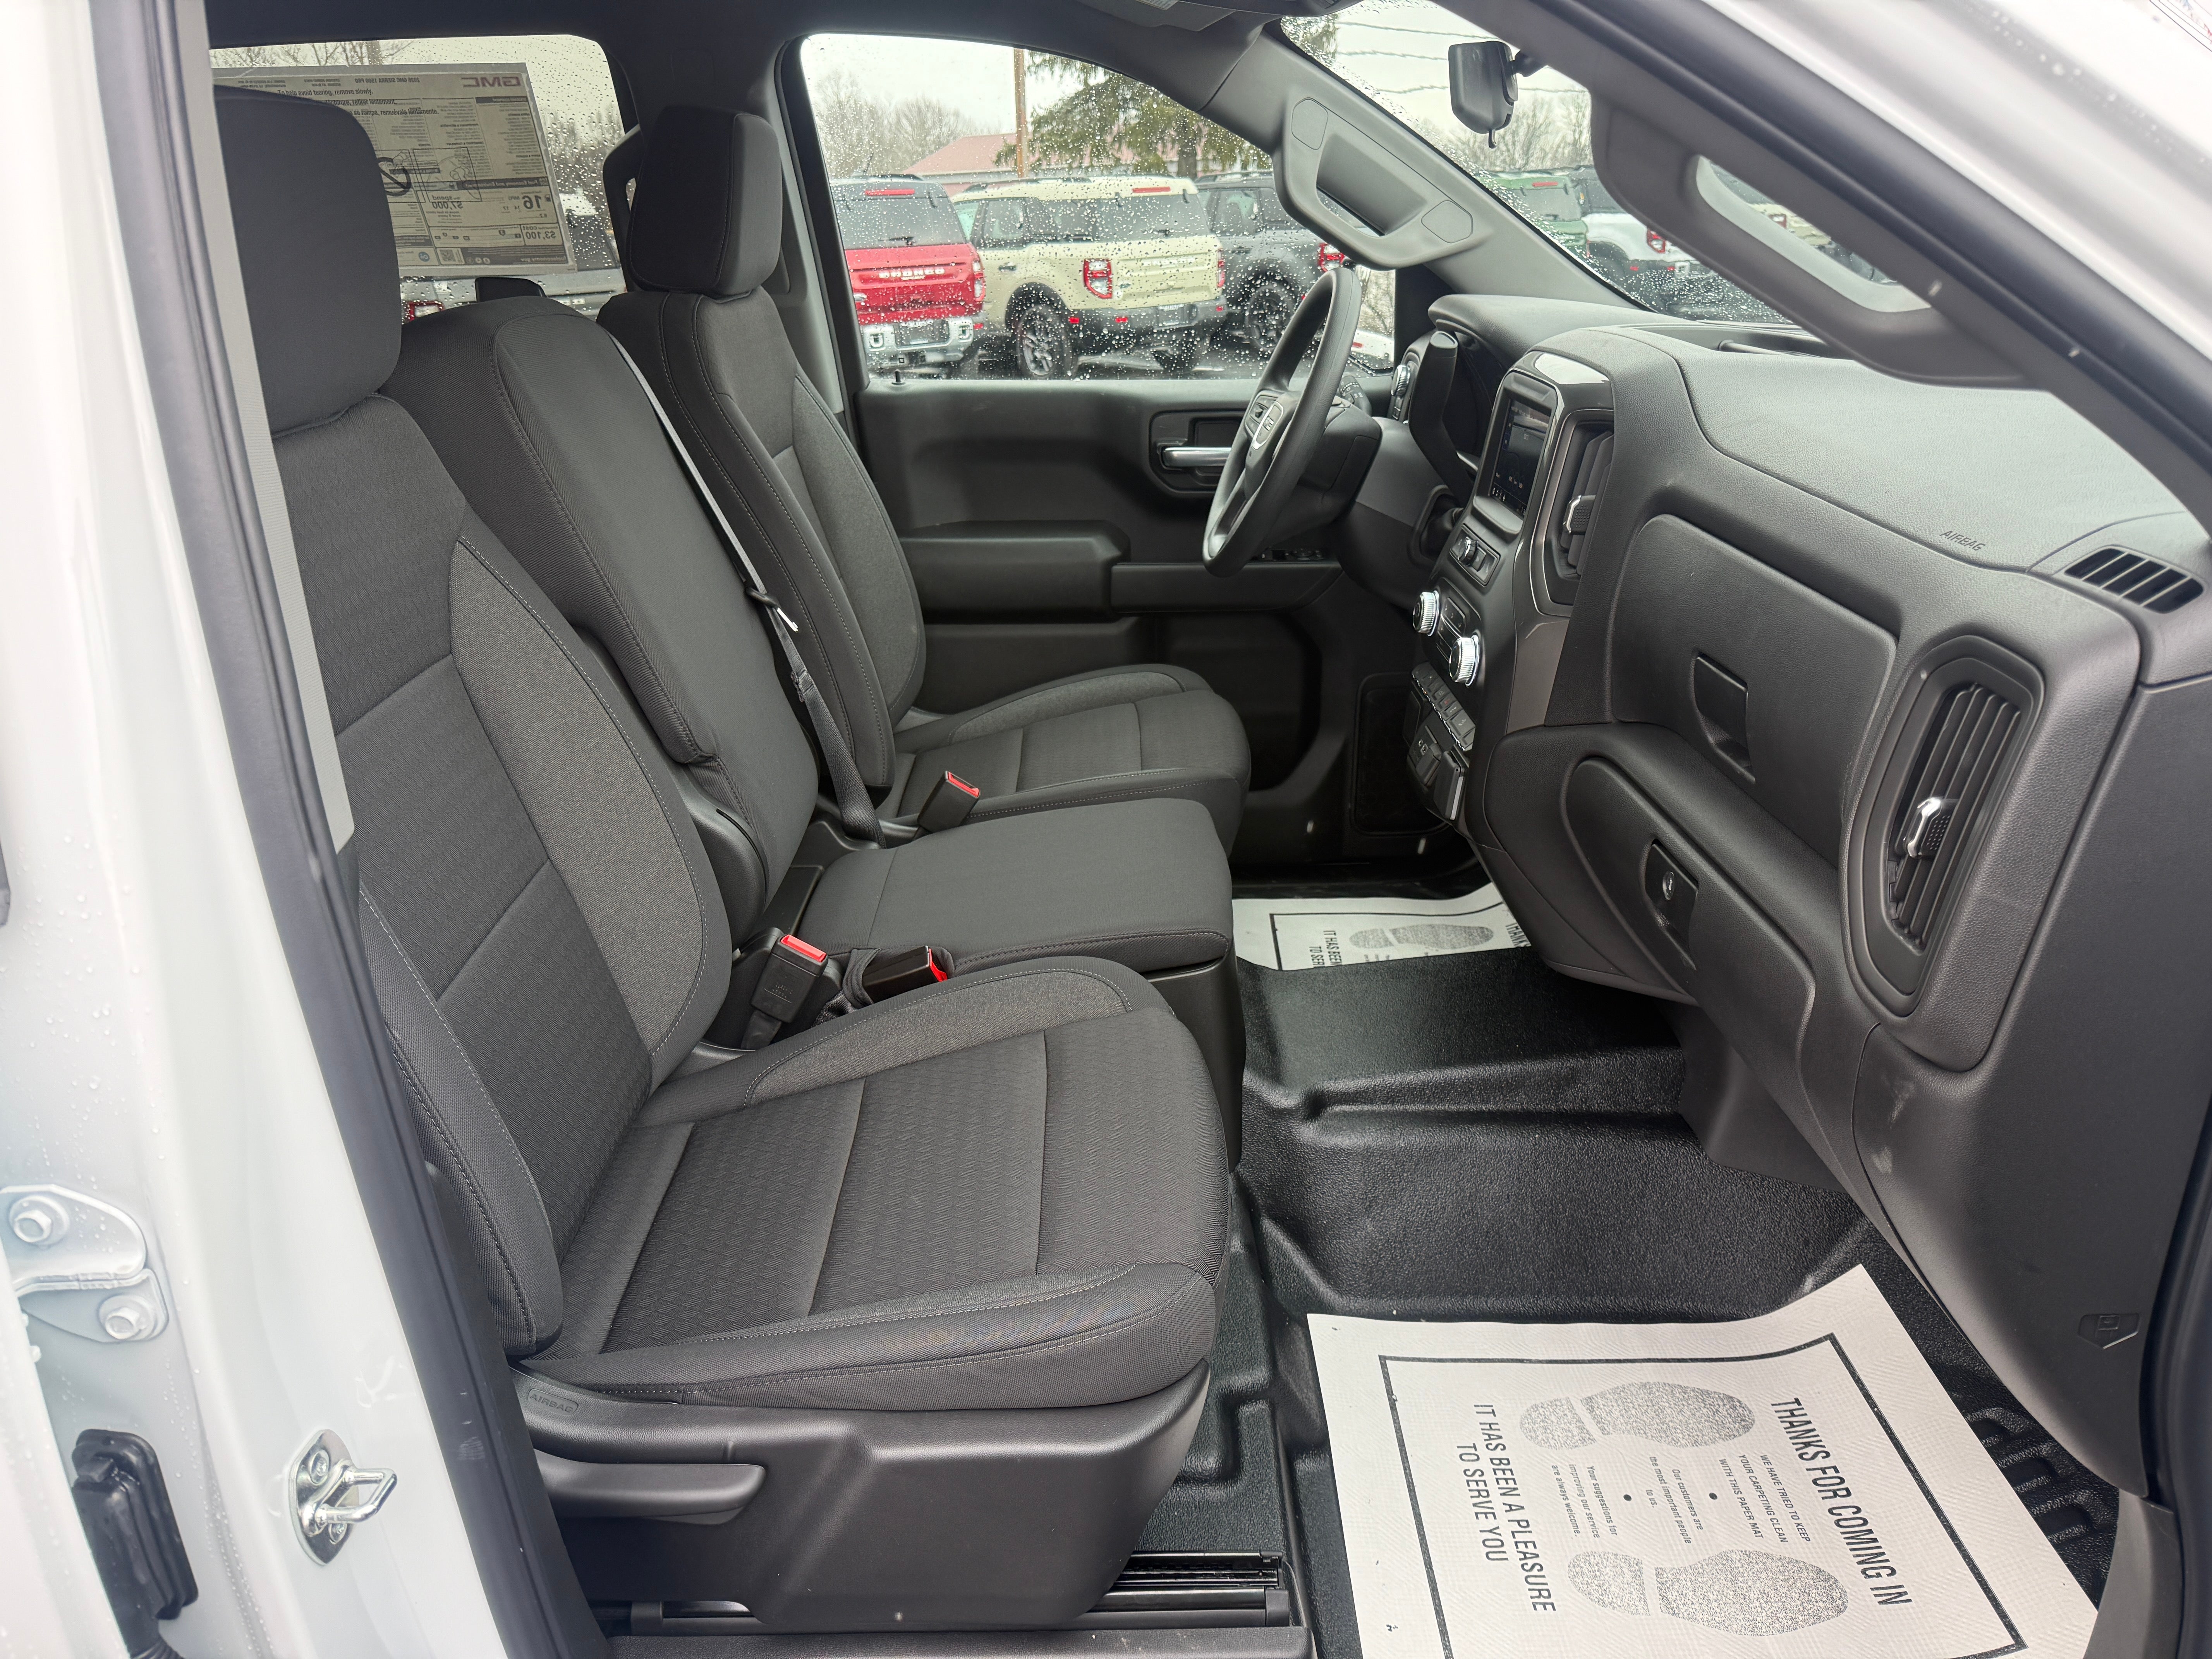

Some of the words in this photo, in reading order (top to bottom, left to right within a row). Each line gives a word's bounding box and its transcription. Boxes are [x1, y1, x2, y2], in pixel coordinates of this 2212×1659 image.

[1939, 531, 1986, 551] AIRBAG
[1325, 937, 1339, 950] HAS
[1311, 955, 1325, 965] SER
[529, 1394, 573, 1413] AIRBAG
[1474, 1405, 1496, 1417] IT
[1479, 1422, 1506, 1451] HAS
[1771, 1397, 1831, 1461] THANKS
[1456, 1443, 1480, 1462] TO
[1760, 1455, 1772, 1466] WE
[1489, 1458, 1521, 1496] BEEN
[1568, 1464, 1585, 1498] improving
[1766, 1467, 1783, 1486] HAVE
[1805, 1465, 1852, 1500] FOR
[1463, 1468, 1497, 1520] SERVE
[1502, 1502, 1525, 1513] A
[1551, 1465, 1560, 1476] are
[1556, 1477, 1569, 1501] always
[1565, 1503, 1580, 1537] welcome.
[1581, 1499, 1590, 1511] our
[1587, 1465, 1597, 1482] Your
[1593, 1483, 1613, 1524] suggestions
[1608, 1525, 1618, 1536] for
[1649, 1456, 1659, 1467] the
[1654, 1468, 1668, 1485] most
[1661, 1486, 1682, 1518] important
[1674, 1520, 1692, 1544] people
[1649, 1498, 1657, 1508] us.
[1672, 1469, 1682, 1481] Our
[1678, 1482, 1698, 1517] customers
[1693, 1518, 1704, 1530] are
[1719, 1458, 1734, 1477] WITH
[1728, 1479, 1742, 1495] THIS
[1737, 1497, 1755, 1521] PAPER
[1749, 1522, 1764, 1539] MAT
[1738, 1455, 1754, 1474] YOUR
[1749, 1476, 1775, 1516] CARPETING
[1770, 1518, 1788, 1542] CLEAN
[1777, 1487, 1794, 1509] TRIED
[1585, 1512, 1600, 1539] service
[1789, 1510, 1800, 1520] TO
[1479, 1526, 1509, 1561] YOU
[1794, 1522, 1811, 1542] KEEP
[1827, 1505, 1897, 1579] COMING
[1507, 1519, 1556, 1611] PLEASURE
[1870, 1584, 1913, 1606] IN
